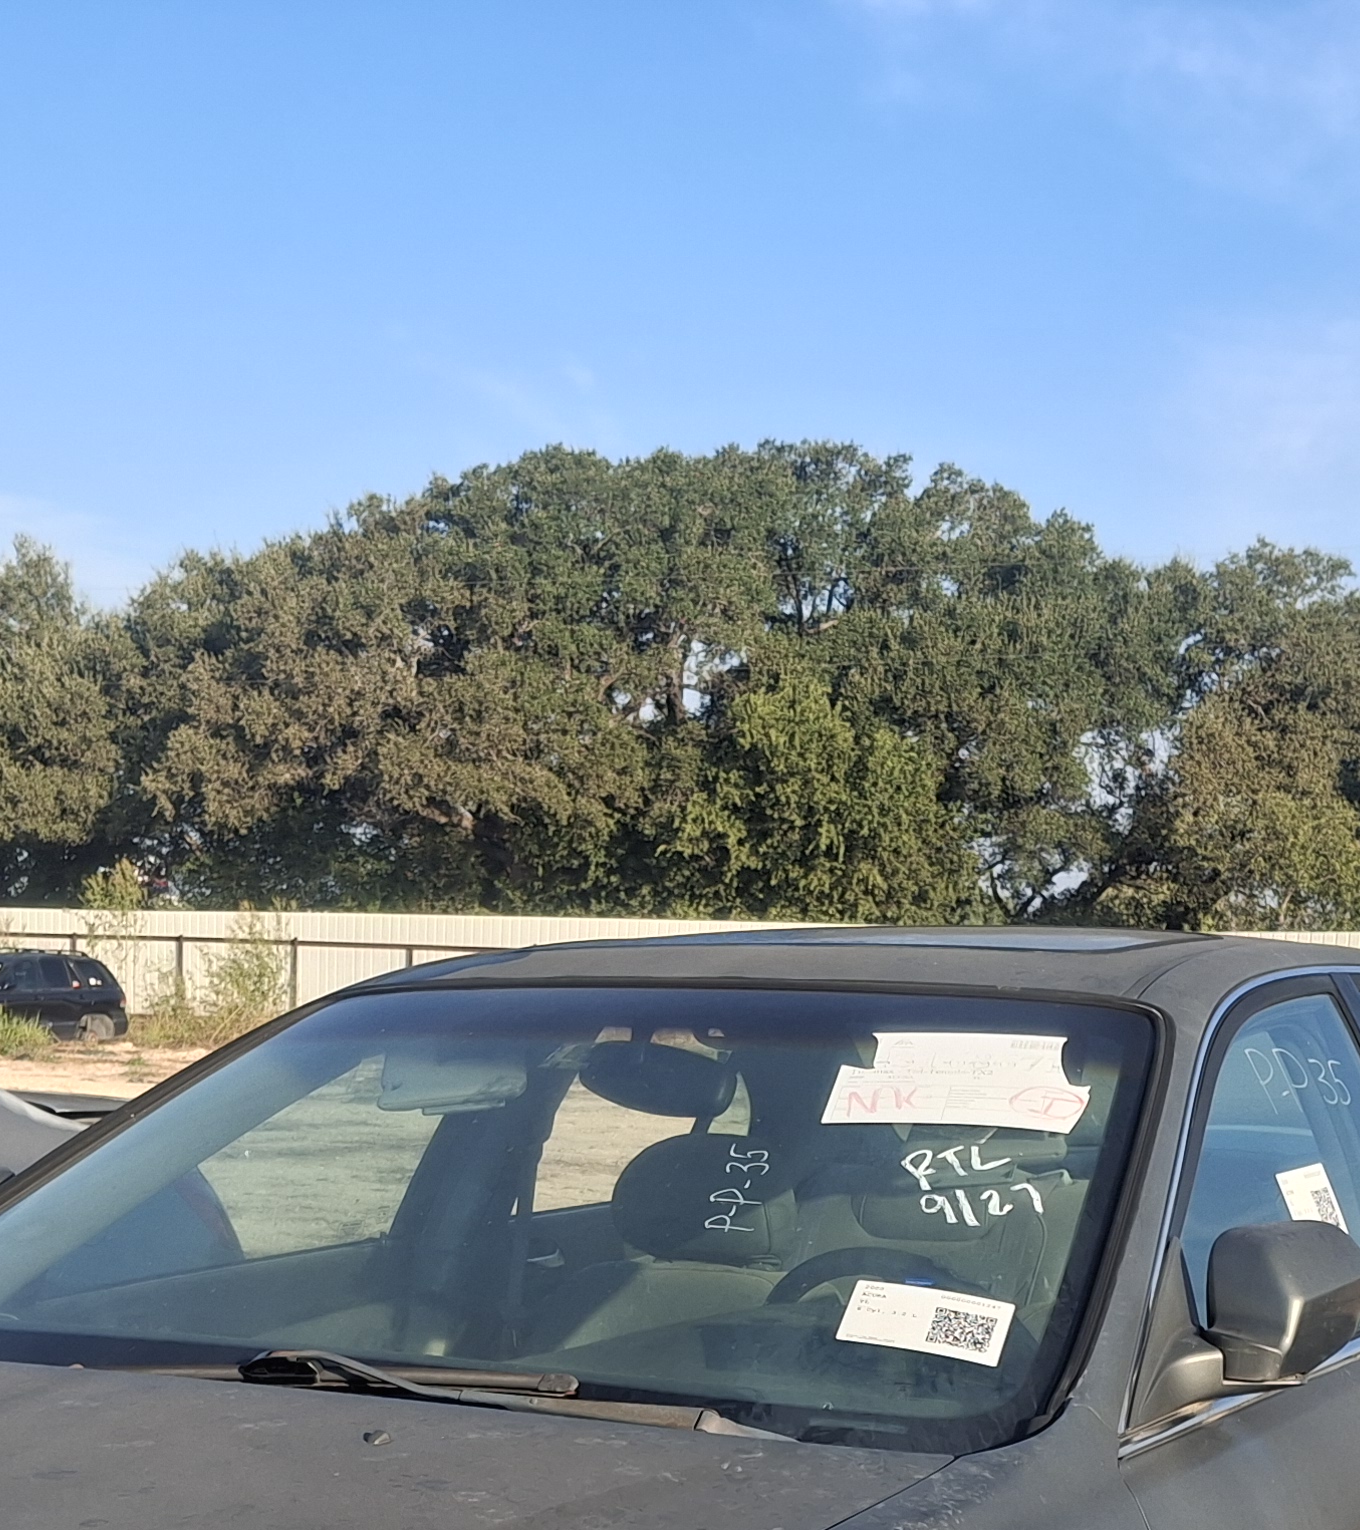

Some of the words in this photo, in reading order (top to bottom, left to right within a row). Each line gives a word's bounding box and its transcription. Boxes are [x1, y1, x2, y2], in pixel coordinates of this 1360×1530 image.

[846, 1086, 918, 1117] NK
[900, 1145, 1012, 1191] RTL
[920, 1182, 1044, 1227] 9/27
